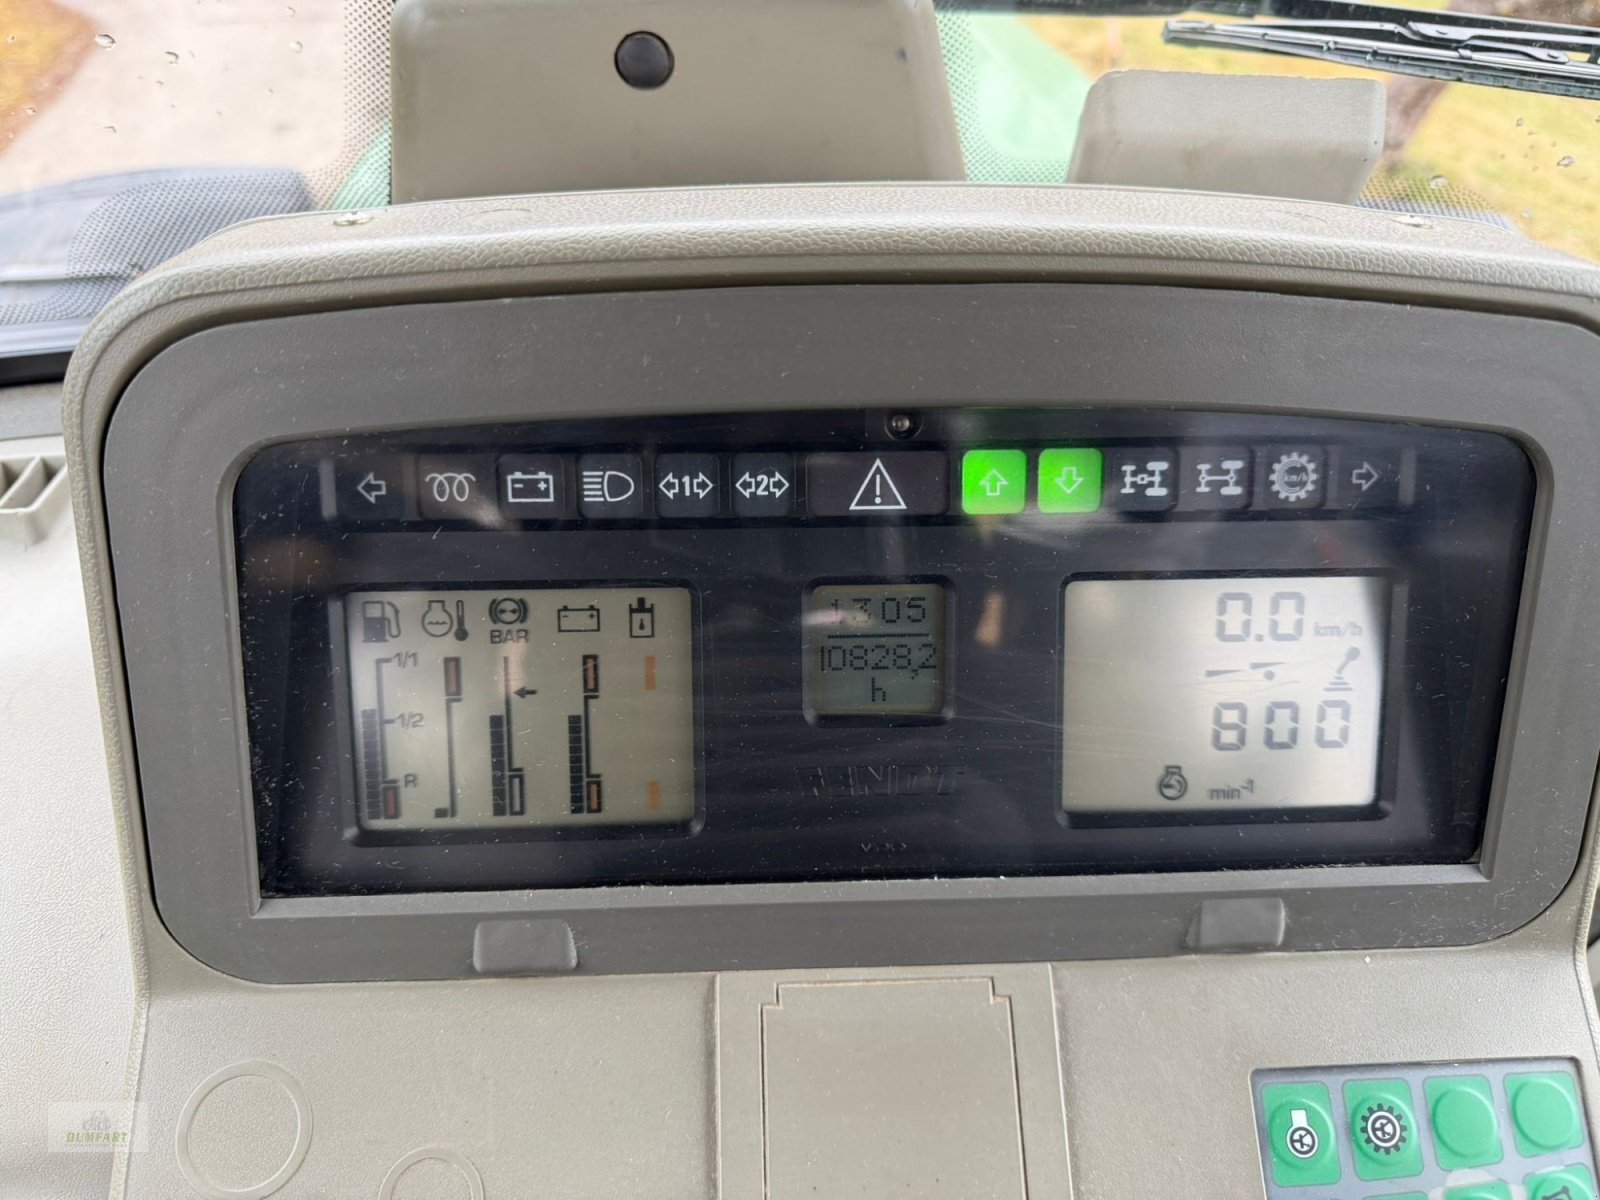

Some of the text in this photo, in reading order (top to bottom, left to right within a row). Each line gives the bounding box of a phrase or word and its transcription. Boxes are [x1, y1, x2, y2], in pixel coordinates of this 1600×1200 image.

[681, 474, 691, 497] 1
[756, 474, 769, 496] 2
[1215, 591, 1362, 642] 0.0 km/h
[490, 629, 529, 644] BAR
[392, 651, 418, 668] 1/1
[871, 676, 886, 702] h
[397, 712, 425, 729] 1/2
[1210, 699, 1351, 751] 800
[404, 773, 418, 788] R
